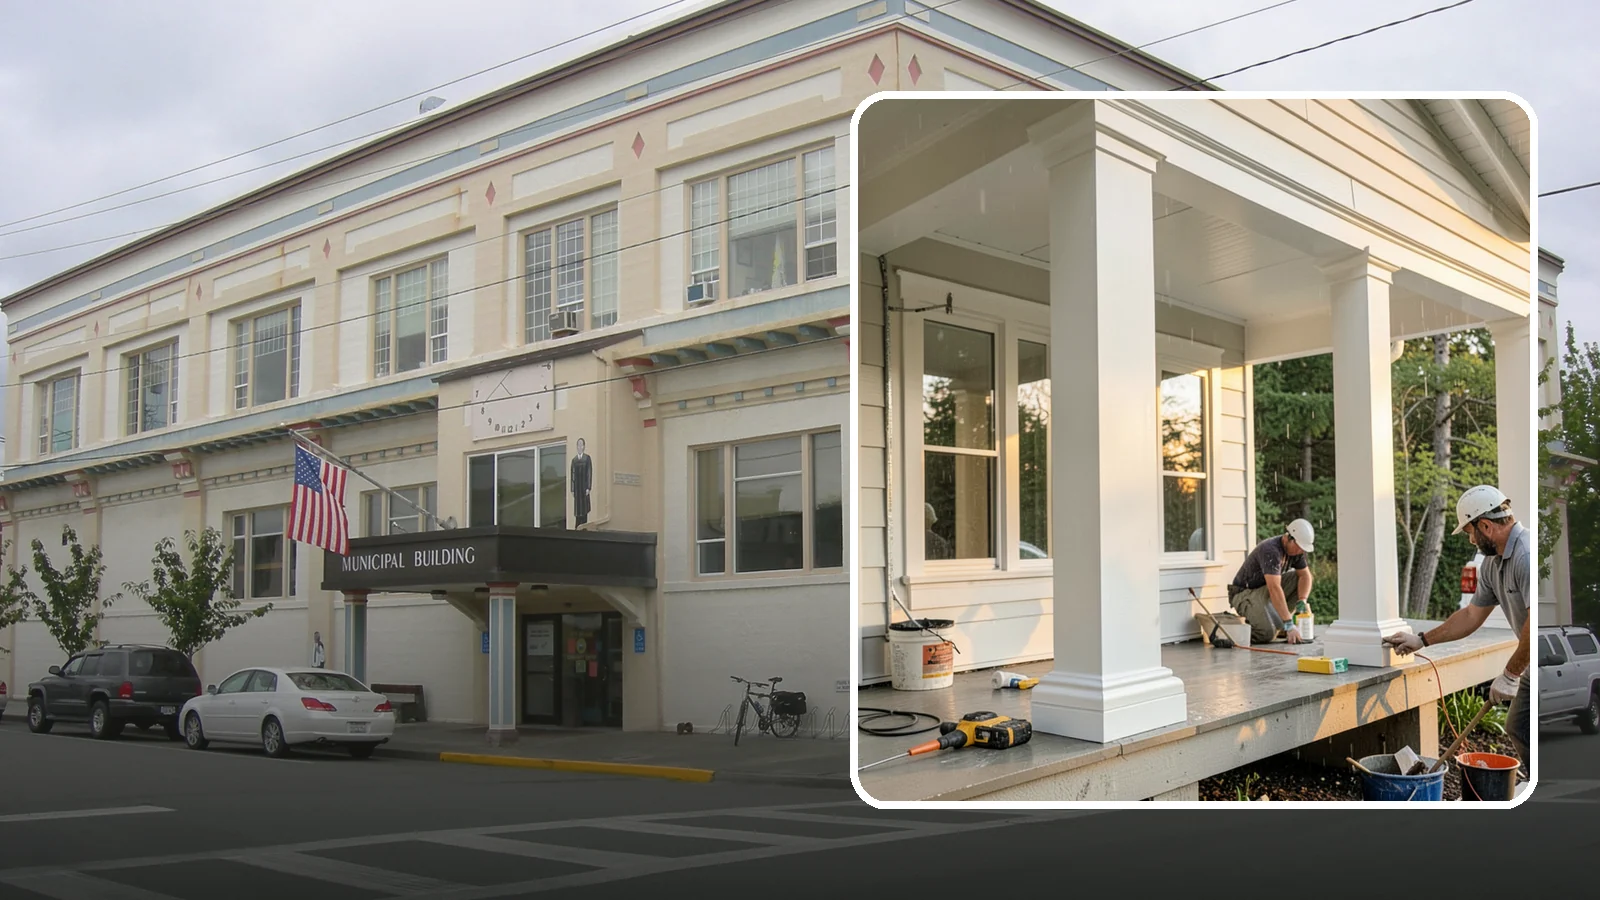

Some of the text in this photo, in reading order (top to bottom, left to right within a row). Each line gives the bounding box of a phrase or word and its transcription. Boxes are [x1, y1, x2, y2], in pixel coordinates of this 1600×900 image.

[475, 390, 479, 398] 7
[481, 407, 485, 415] 8
[488, 417, 492, 425] 9
[495, 423, 501, 432] 10
[507, 425, 513, 433] 12
[521, 420, 525, 428] 2
[529, 414, 533, 422] 3
[536, 402, 540, 410] 4
[342, 546, 475, 572] MUNICIPAL BUILDING
